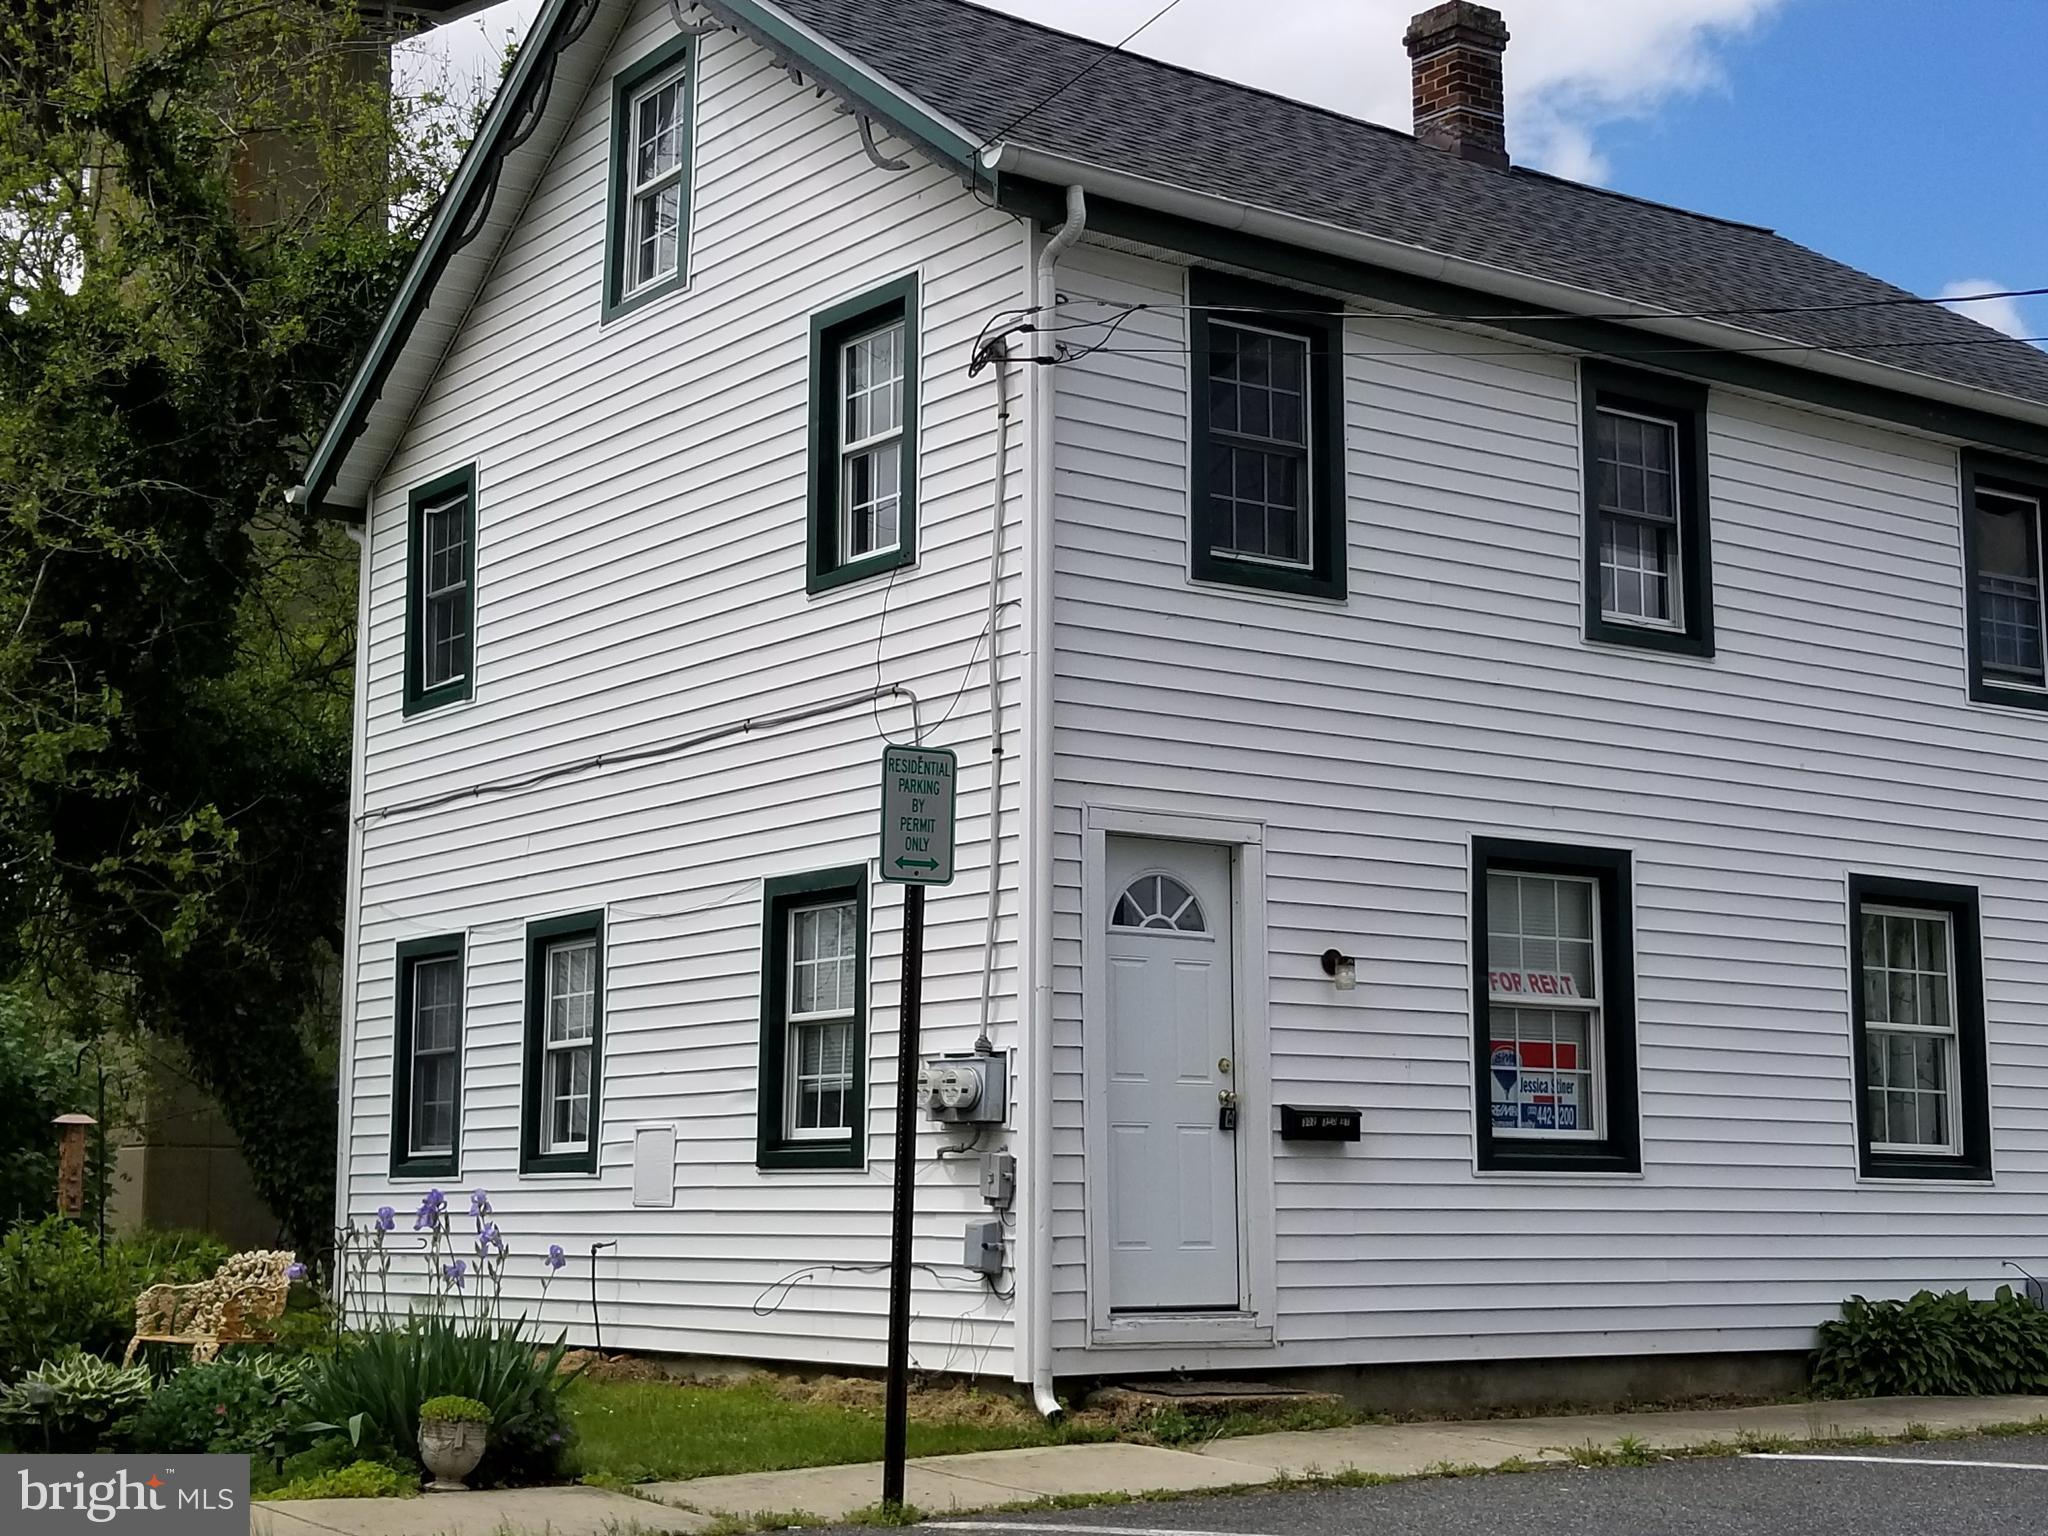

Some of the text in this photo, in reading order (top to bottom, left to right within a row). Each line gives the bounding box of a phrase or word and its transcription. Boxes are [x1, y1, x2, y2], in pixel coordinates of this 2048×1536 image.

[888, 757, 951, 777] RESIDENTIAL
[898, 778, 940, 795] PARKING
[912, 798, 925, 813] BY
[900, 816, 936, 833] PERMIT
[905, 836, 929, 852] ONLY
[1488, 972, 1572, 995] FOR RENT
[1519, 1077, 1548, 1093] Jessica
[1537, 1106, 1575, 1126] 442-200
